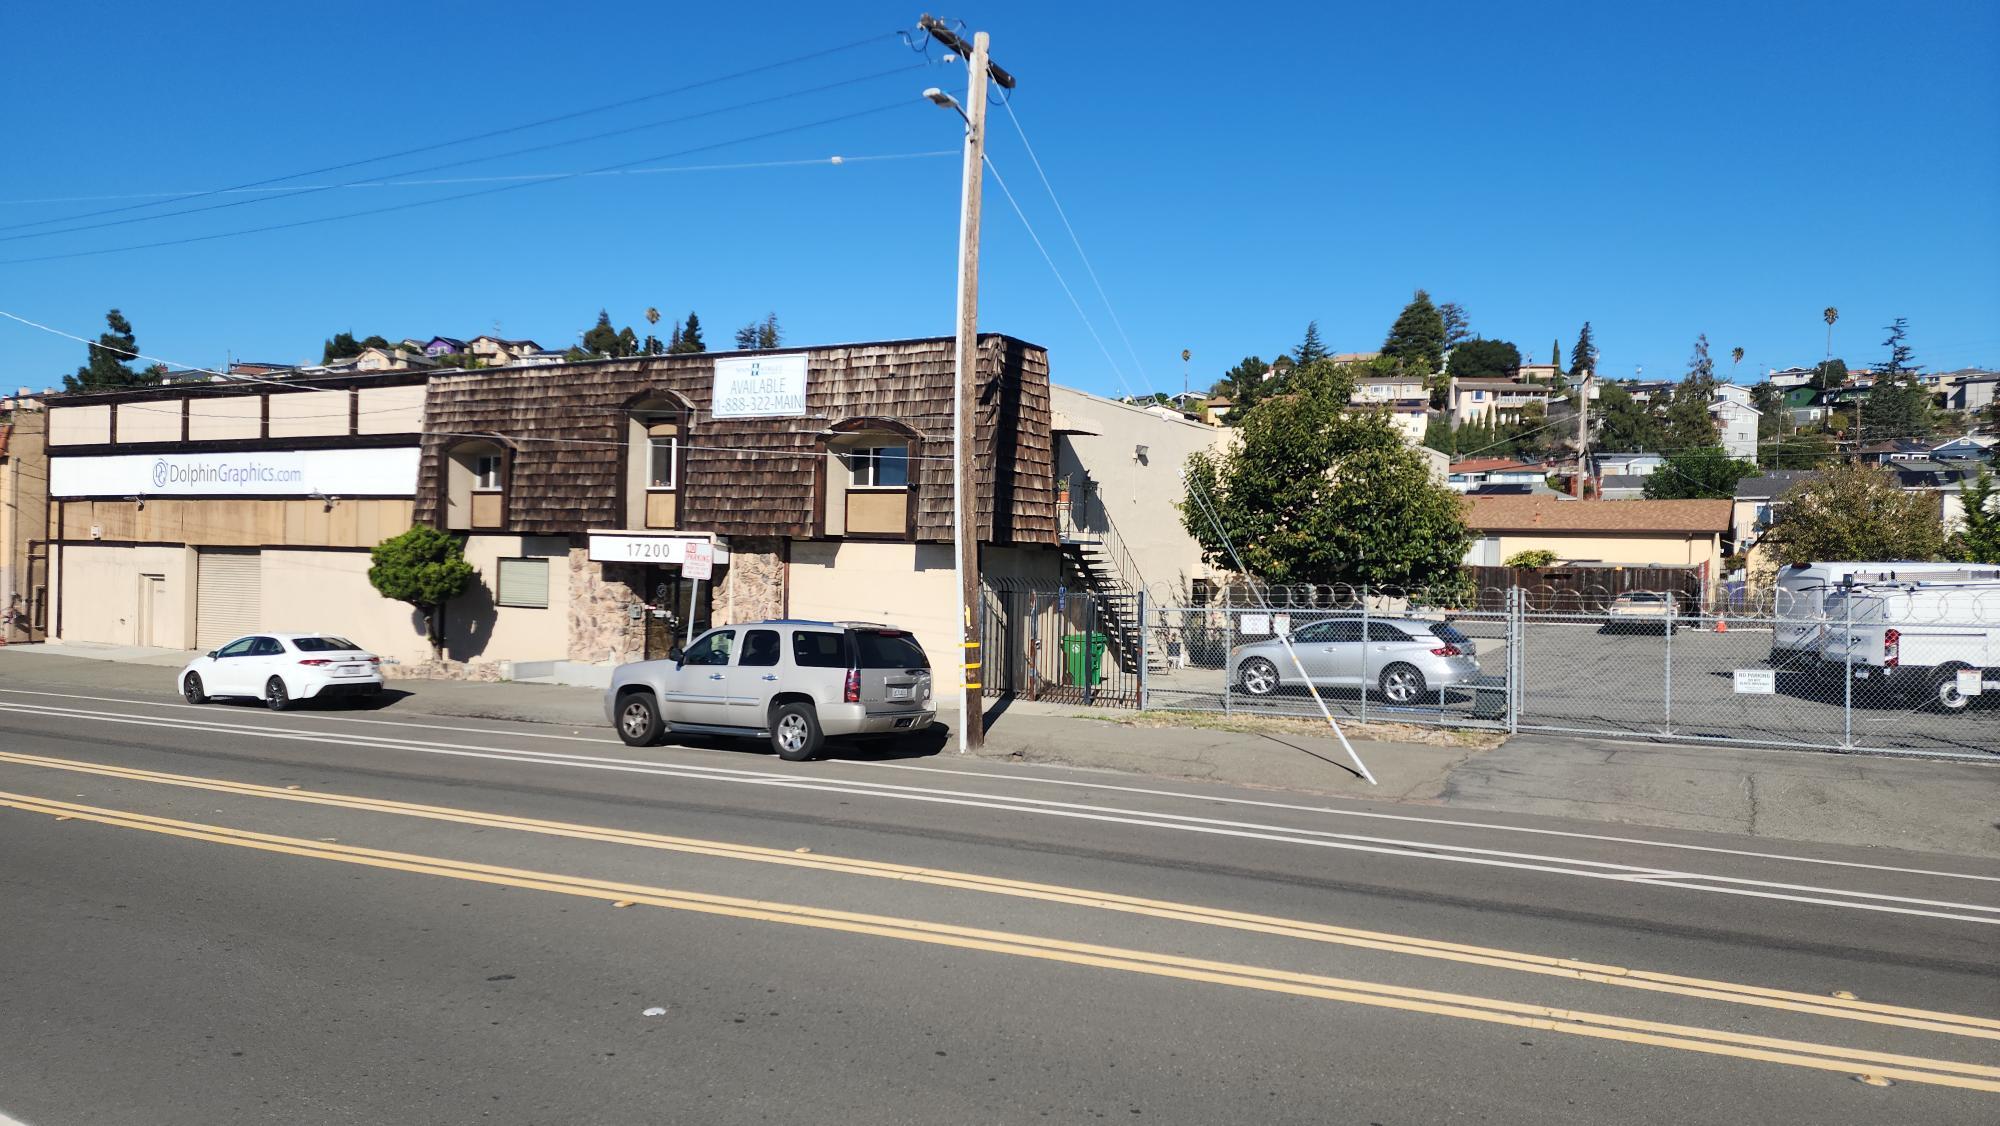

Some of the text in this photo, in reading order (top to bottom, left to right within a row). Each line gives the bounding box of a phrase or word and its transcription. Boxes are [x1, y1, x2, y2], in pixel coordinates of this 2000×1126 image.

[730, 378, 787, 395] AVAILABLE
[717, 394, 802, 412] 1-888-322-MAIN
[169, 462, 301, 487] DolphinGraphics.com
[626, 543, 670, 557] 17200
